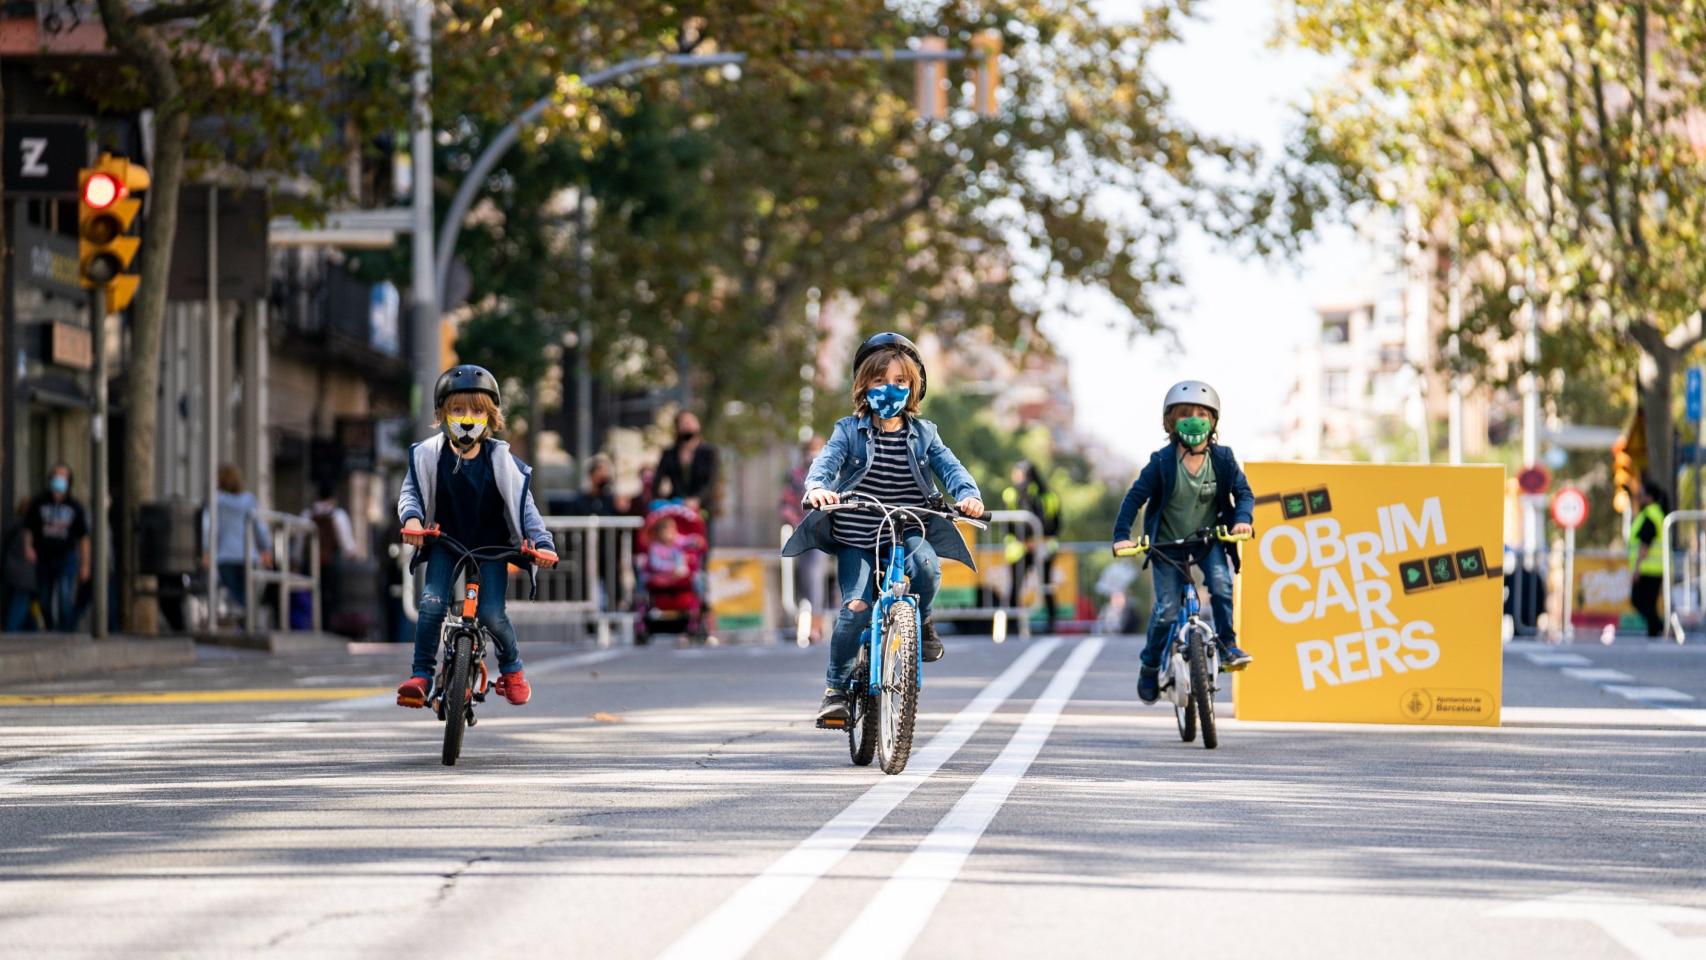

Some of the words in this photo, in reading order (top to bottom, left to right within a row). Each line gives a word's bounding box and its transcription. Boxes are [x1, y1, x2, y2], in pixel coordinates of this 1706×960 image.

[20, 138, 49, 177] Z
[1259, 496, 1448, 583] OBRIM
[1268, 566, 1399, 630] CAR
[1296, 620, 1441, 691] RERS
[1436, 703, 1482, 712] Barcelona
